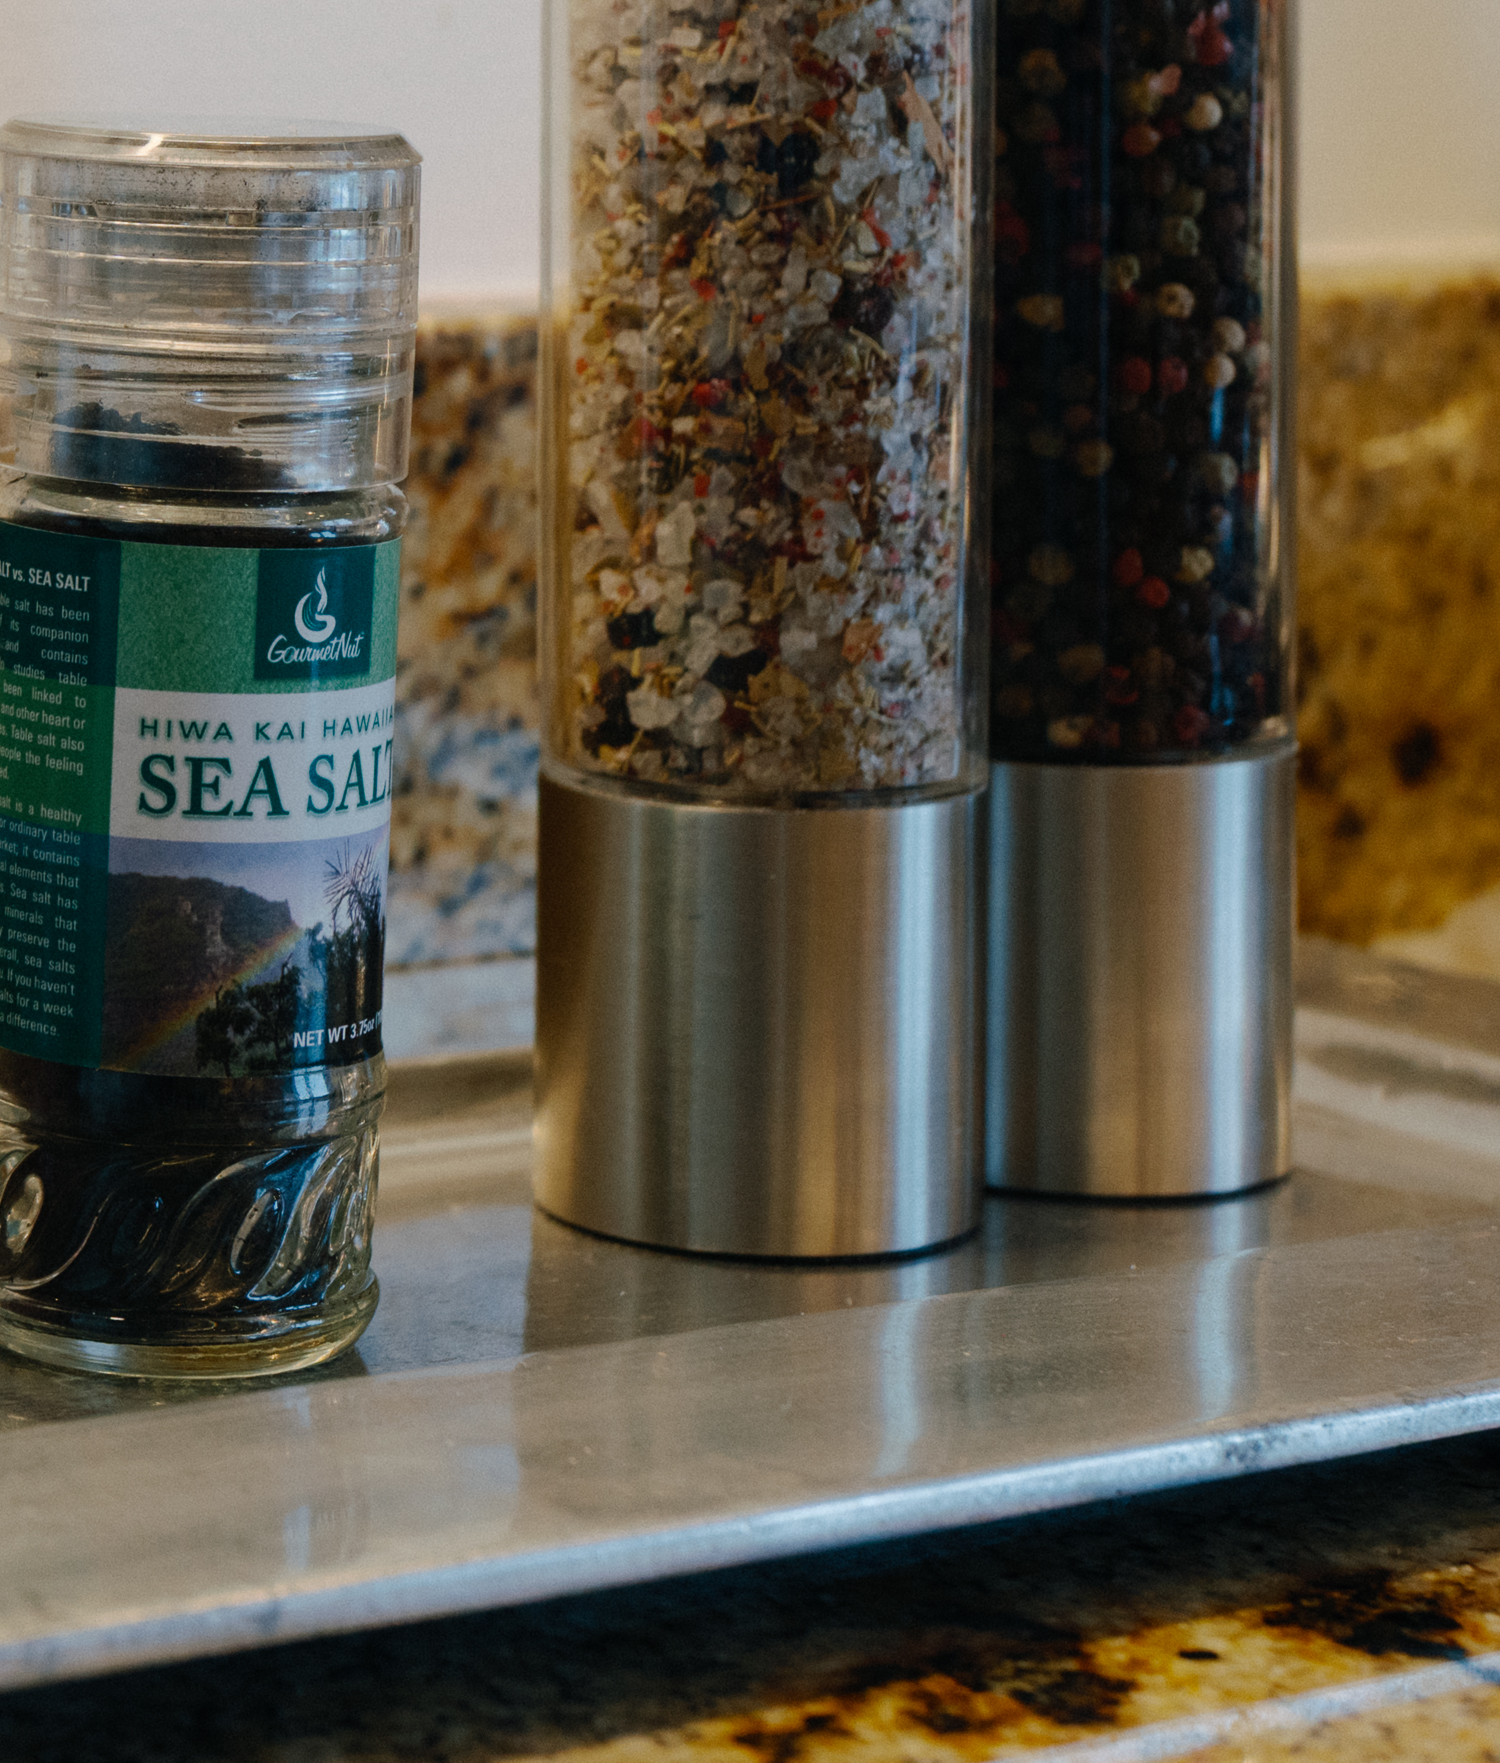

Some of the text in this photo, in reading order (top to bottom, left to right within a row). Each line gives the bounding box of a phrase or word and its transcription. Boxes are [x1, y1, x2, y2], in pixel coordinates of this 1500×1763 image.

[12, 568, 25, 582] vs.
[29, 568, 51, 587] SEA
[56, 573, 91, 592] SALT
[15, 599, 30, 613] salt
[36, 601, 54, 616] has
[61, 606, 90, 621] been
[10, 617, 19, 632] its
[30, 625, 89, 643] companion
[5, 639, 88, 665] and contains
[267, 632, 362, 664] GourmetNut
[13, 663, 45, 680] studies
[59, 672, 87, 686] table
[3, 680, 22, 696] been
[31, 687, 62, 705] linked
[75, 696, 86, 708] to
[1, 703, 86, 730] and other heart or
[140, 717, 233, 741] HIWA
[255, 721, 306, 741] KAI
[11, 724, 33, 742] Table
[37, 733, 56, 747] salt
[61, 736, 84, 752] also
[25, 750, 40, 766] the
[45, 754, 83, 776] feeling
[138, 739, 393, 817] SEA SALT
[15, 798, 23, 813] is
[28, 805, 34, 815] a
[41, 804, 82, 827] healthy
[9, 821, 48, 842] ordinary
[52, 830, 81, 845] table
[22, 843, 28, 856] it
[33, 849, 80, 867] contains
[9, 863, 52, 884] elements
[56, 873, 79, 889] that
[10, 882, 26, 900] Sea
[32, 891, 51, 905] salt
[57, 894, 78, 910] has
[5, 904, 43, 925] minerals
[54, 916, 77, 932] that
[8, 928, 50, 948] preserve
[58, 938, 76, 953] the
[25, 955, 42, 968] sea
[48, 959, 75, 975] salts
[15, 973, 31, 987] you
[34, 976, 74, 996] haven't
[17, 992, 30, 1008] for
[33, 1000, 39, 1011] a
[43, 1002, 74, 1017] week
[0, 1012, 4, 1022] a
[7, 1012, 60, 1037] difference.
[294, 1029, 324, 1048] NET
[328, 1025, 348, 1043] WT
[350, 1018, 374, 1039] 3.75oz
